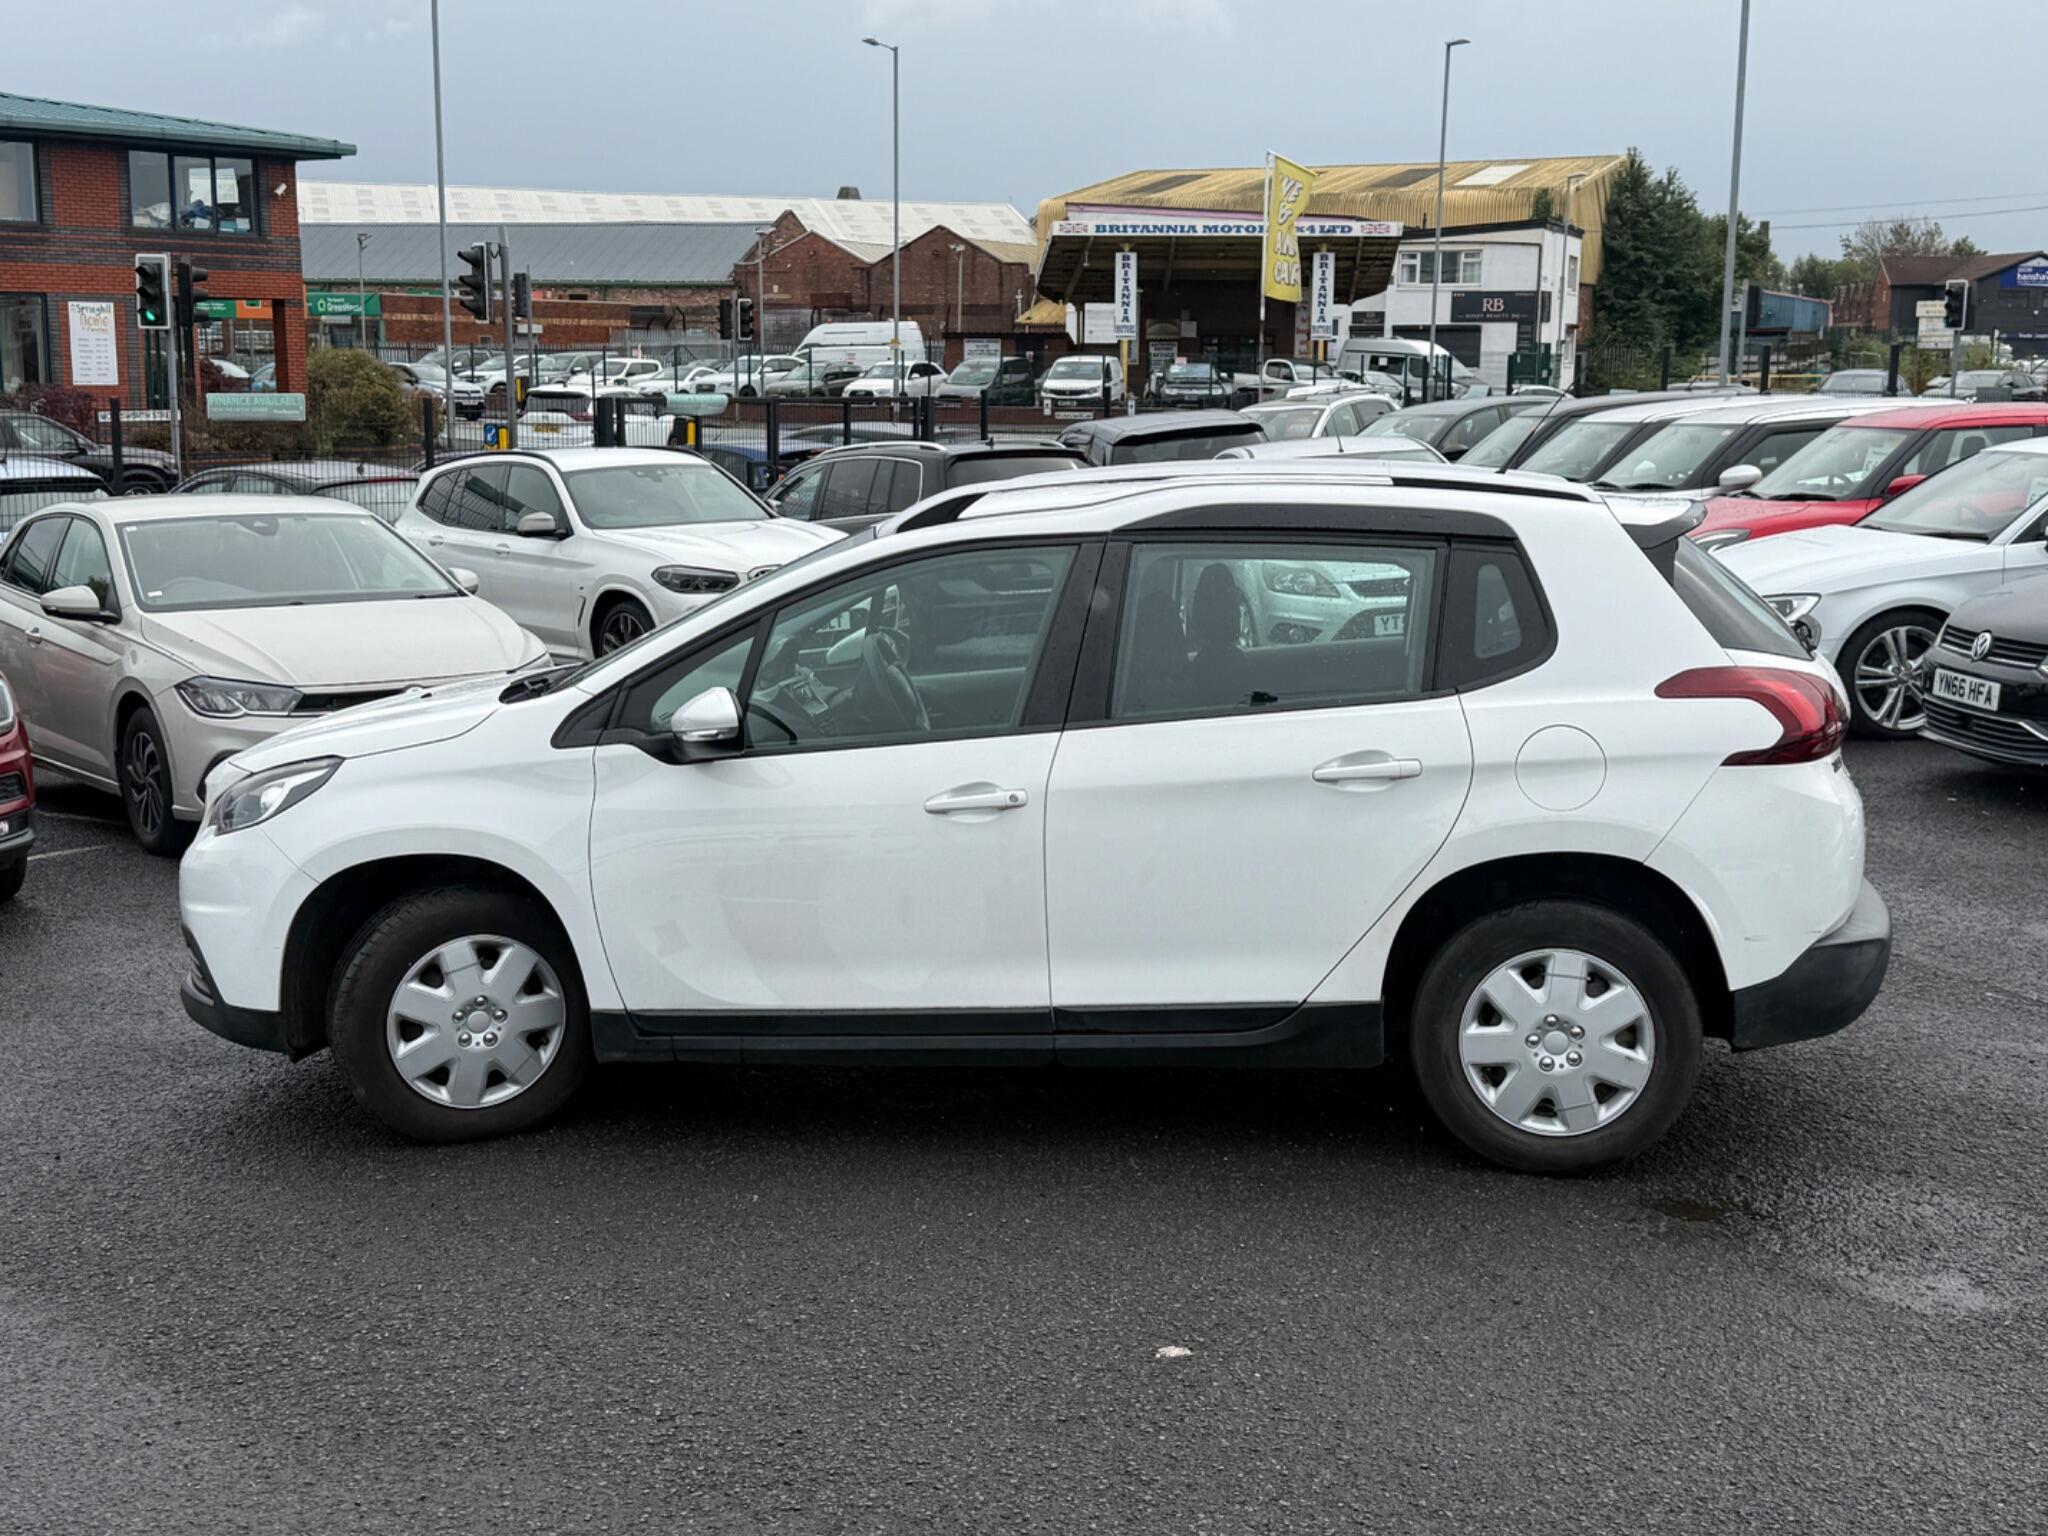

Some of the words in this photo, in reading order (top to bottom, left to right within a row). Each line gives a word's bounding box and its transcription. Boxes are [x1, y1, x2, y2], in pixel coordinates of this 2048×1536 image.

[1094, 224, 1198, 234] BRITANNIA
[1202, 224, 1264, 234] MOTO
[1319, 224, 1353, 234] LTD
[1121, 254, 1131, 323] BRITANNIA
[1317, 253, 1329, 323] BRITANNIA
[1482, 298, 1505, 312] RB
[209, 396, 252, 406] FINANCE
[1938, 671, 1966, 698] YN66
[1967, 679, 1993, 706] HFA
